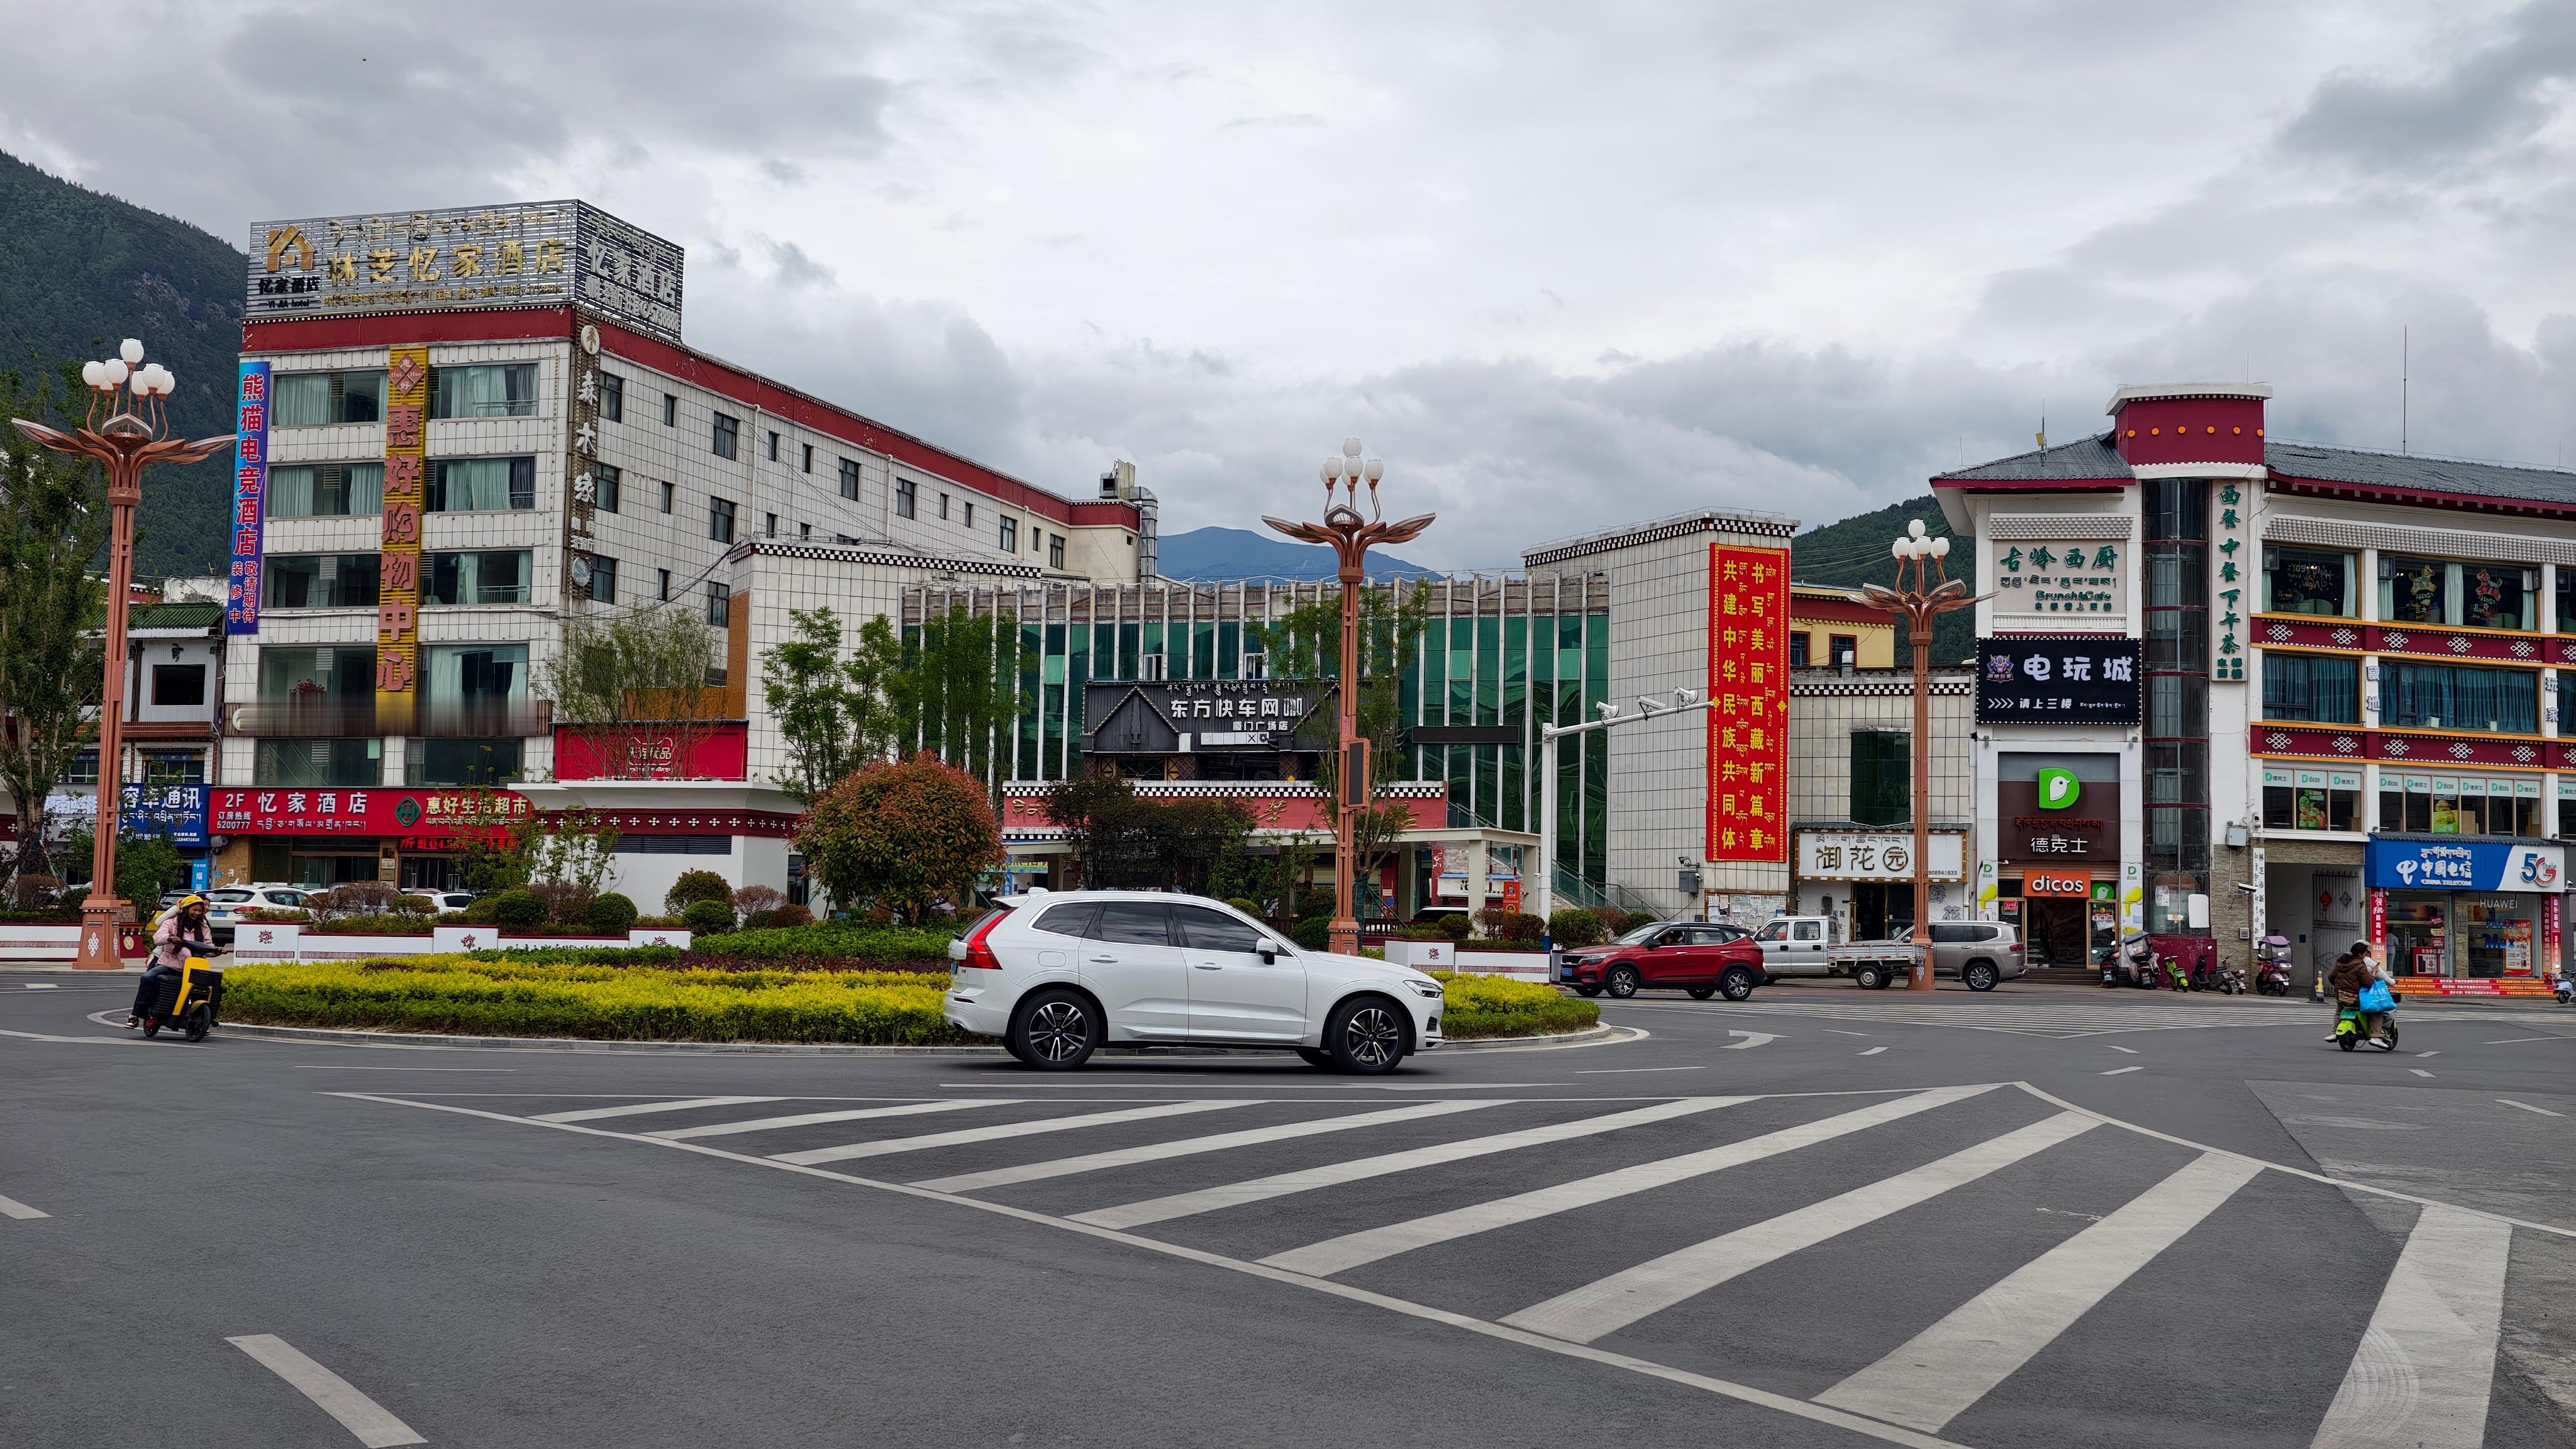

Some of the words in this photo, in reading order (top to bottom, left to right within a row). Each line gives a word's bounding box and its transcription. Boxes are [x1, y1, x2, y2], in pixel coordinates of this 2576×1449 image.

[326, 238, 567, 287] 林芝忆家酒店
[587, 237, 677, 306] 忆家酒店
[258, 276, 321, 294] 忆家酒店
[291, 299, 309, 308] hotel
[233, 372, 265, 557] 熊猫电竞酒店
[377, 402, 421, 692] 惠好购物中心
[229, 561, 243, 623] 装修中
[242, 560, 258, 623] 敬请期待
[2023, 653, 2133, 682] 电玩城
[2367, 665, 2380, 712] 藏地
[2545, 676, 2559, 723] 玩家
[1170, 697, 1302, 718] 东方快车网咖
[1722, 559, 1738, 851] 共建中华民族共同体
[1750, 561, 1765, 851] 书写美丽西藏新篇章
[2019, 698, 2072, 709] 请上三楼
[225, 793, 245, 808] 2F
[257, 792, 368, 814] 忆家酒店
[426, 796, 528, 815] 惠好生活超市
[217, 821, 250, 830] 5200777
[218, 811, 251, 820] 订房热线
[2031, 837, 2088, 853] 德克士
[1816, 845, 1909, 872] 御花园
[2421, 859, 2472, 879] 中国电信
[2521, 852, 2557, 887] 5G
[2032, 875, 2084, 892] dicos
[2480, 899, 2518, 909] HUAWEI
[2485, 934, 2516, 949] Max
